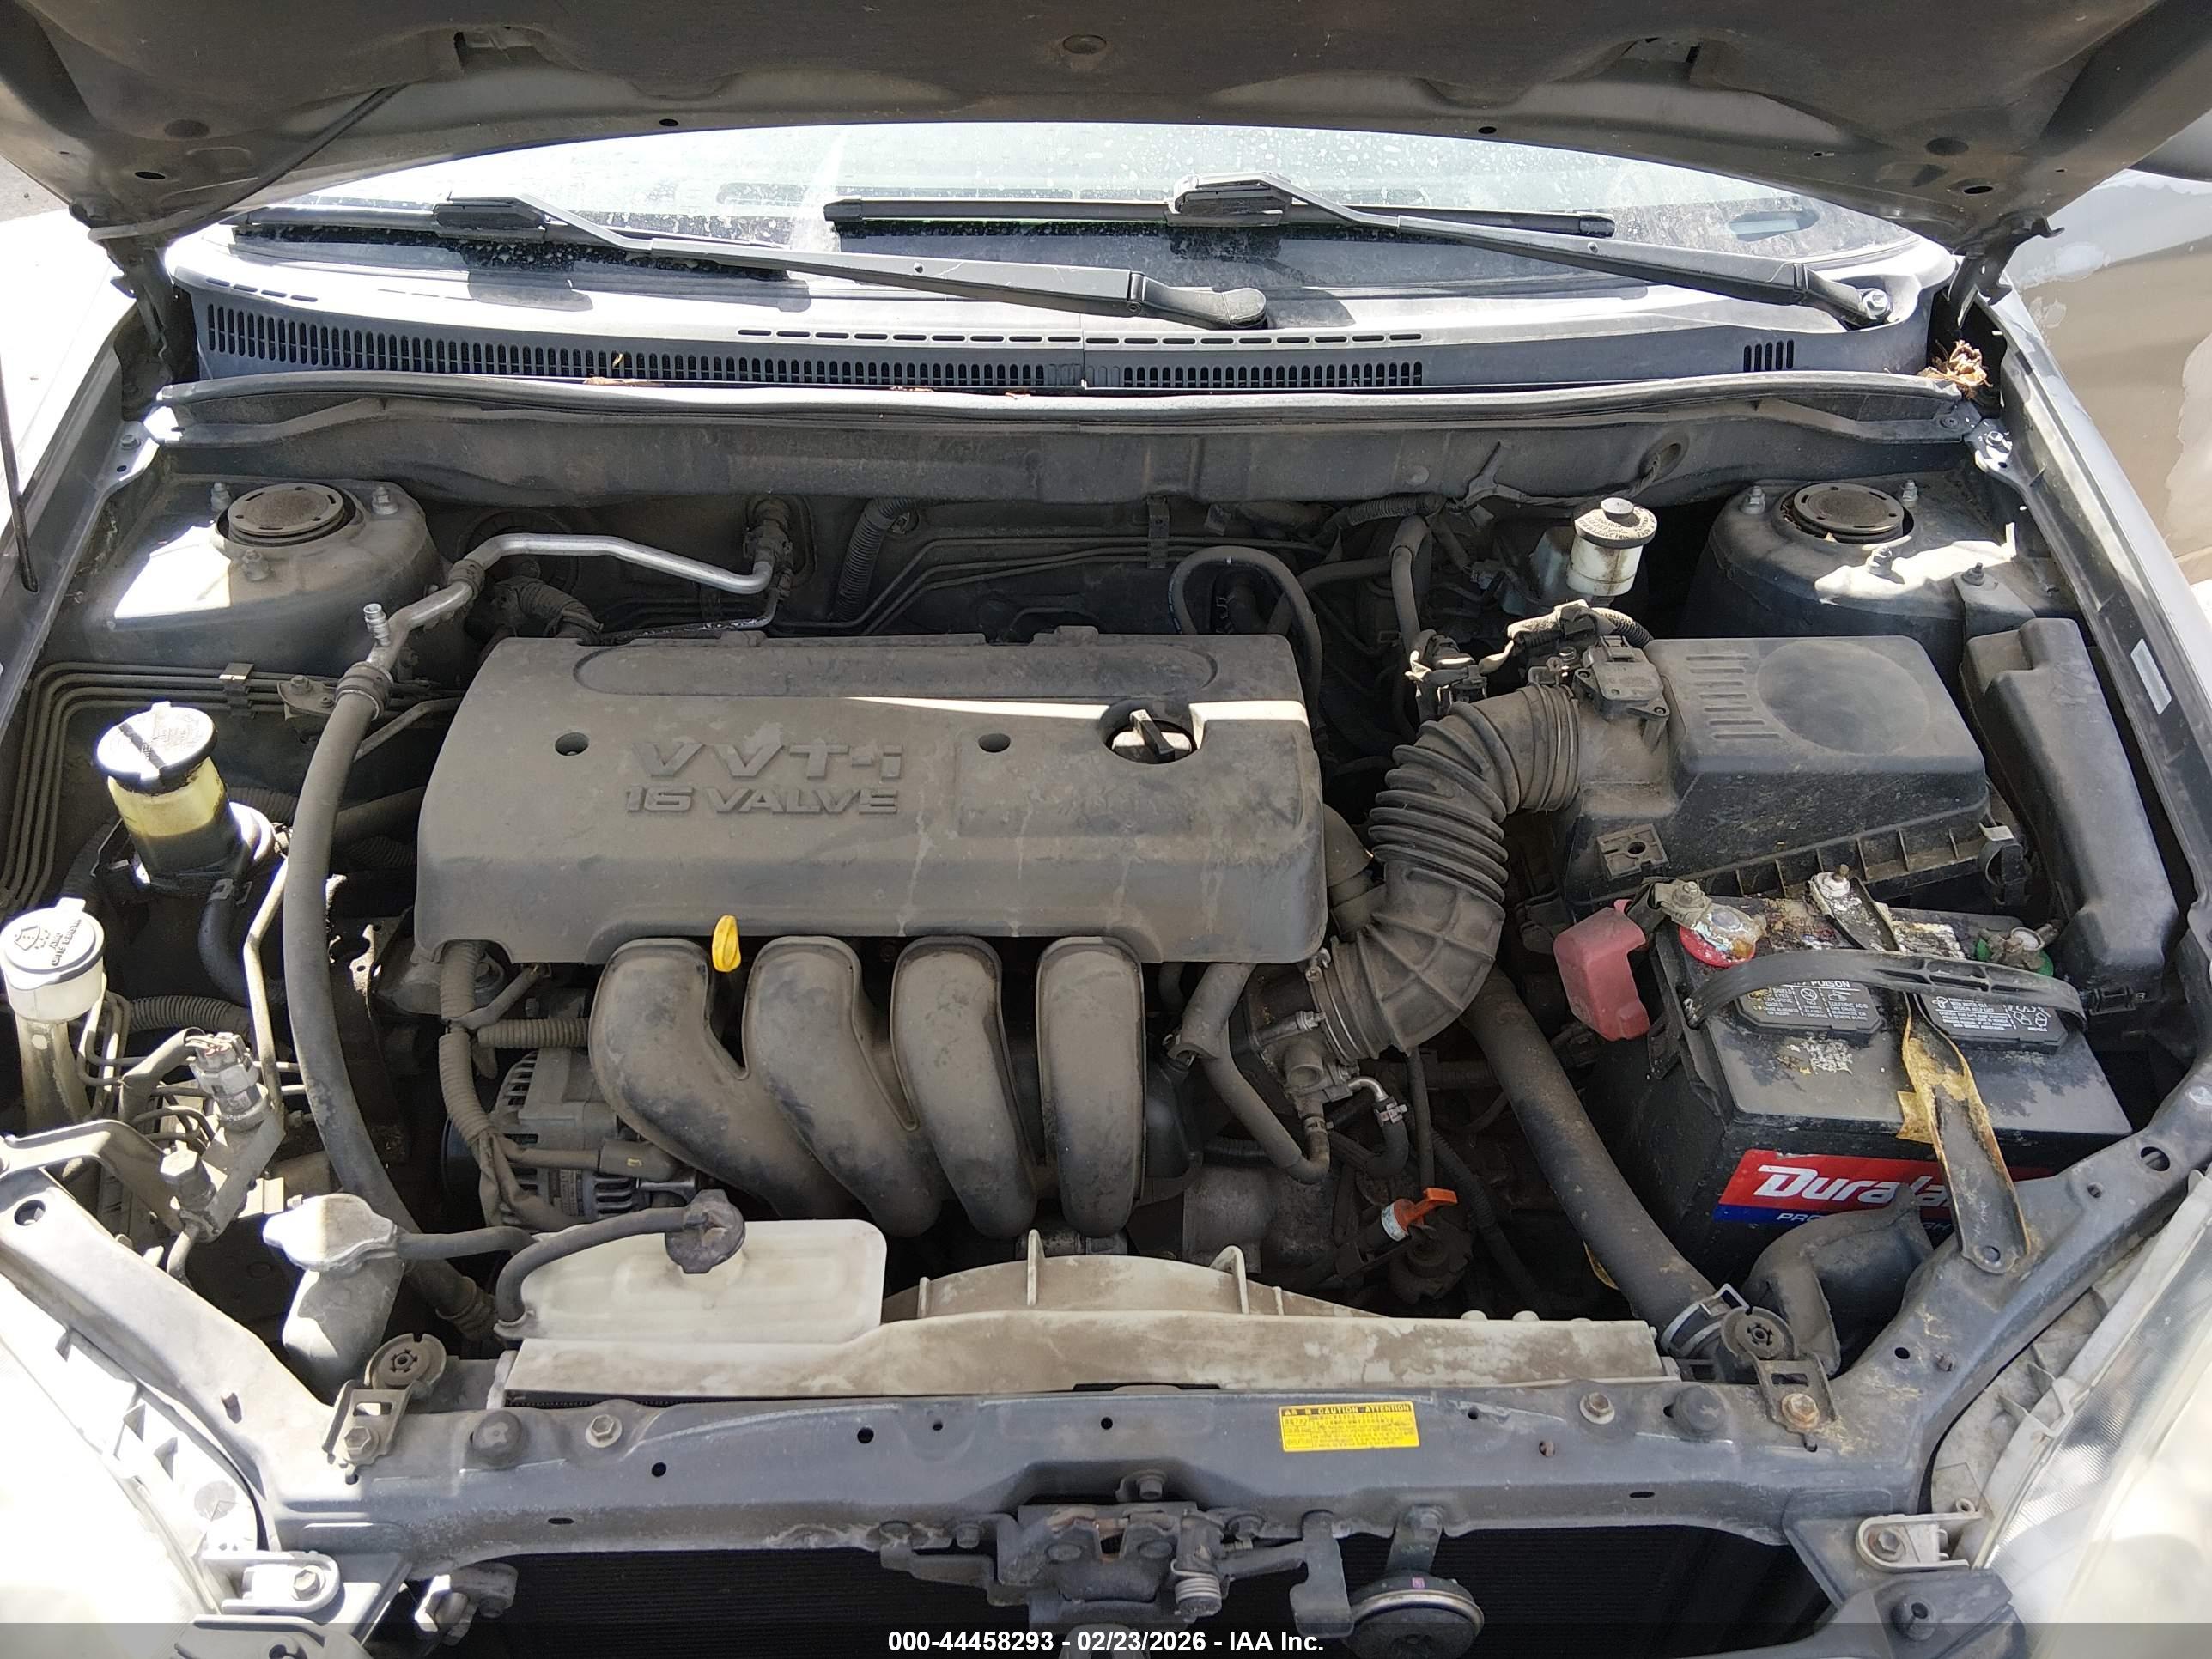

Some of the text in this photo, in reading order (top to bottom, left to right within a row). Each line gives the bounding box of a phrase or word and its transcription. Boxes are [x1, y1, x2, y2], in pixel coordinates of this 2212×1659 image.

[632, 743, 902, 780] VVT-i
[625, 786, 899, 813] 16 VALVE
[1753, 1164, 1951, 1207] Durala
[1317, 1406, 1358, 1415] CAUTION
[1365, 1402, 1410, 1413] ATTENTION
